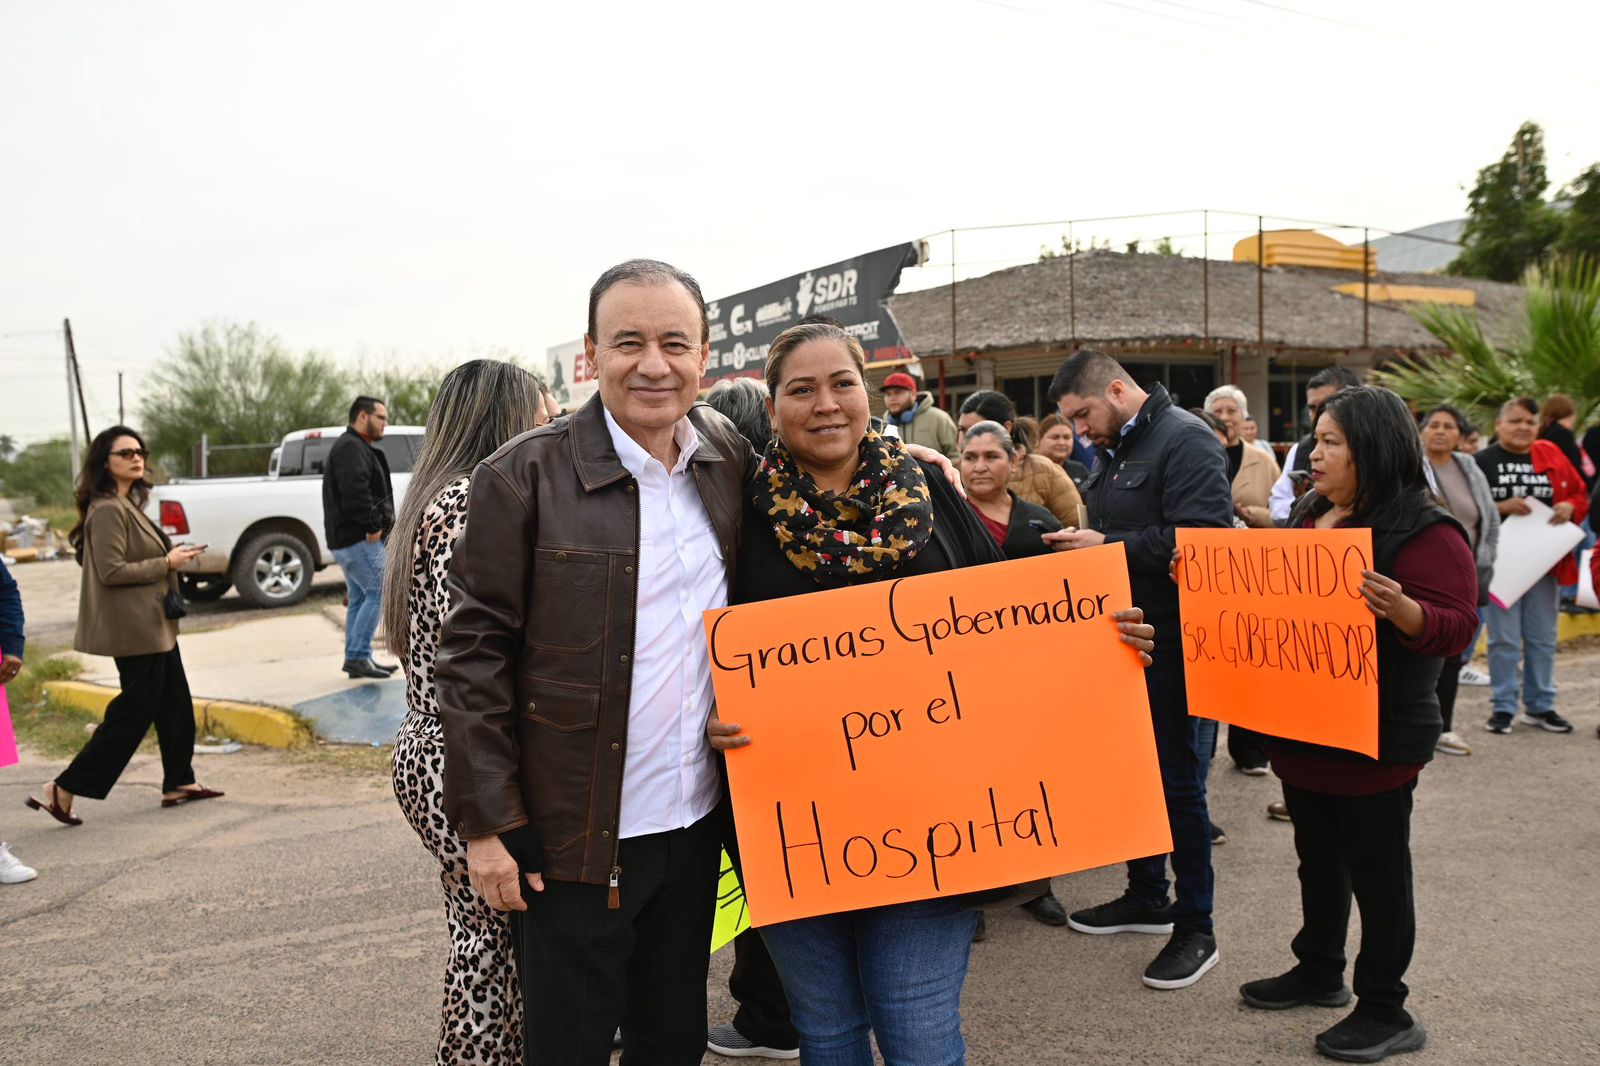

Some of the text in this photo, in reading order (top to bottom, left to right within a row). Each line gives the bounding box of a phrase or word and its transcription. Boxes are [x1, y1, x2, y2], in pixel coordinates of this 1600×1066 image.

[814, 269, 858, 304] SDR
[1491, 487, 1507, 498] TO
[1512, 486, 1528, 497] BE
[1498, 474, 1551, 485] MY GAM
[1506, 462, 1537, 473] PAU
[1183, 543, 1368, 600] BIENVENIDO
[710, 578, 1110, 689] Gracias Gobernador
[1218, 609, 1379, 686] GOBERNADOR
[841, 671, 962, 771] por el
[776, 780, 1058, 899] Hospital
